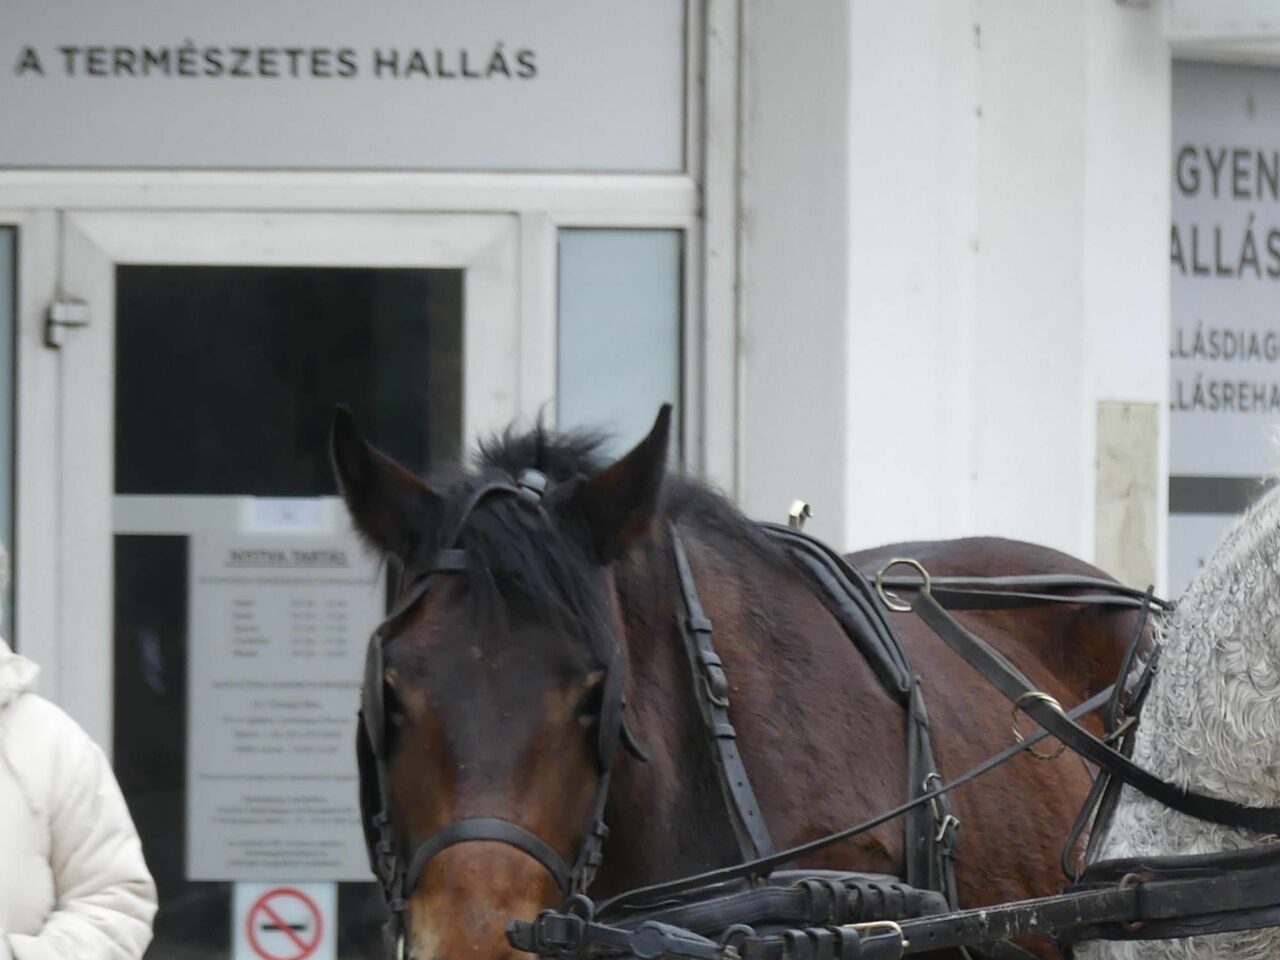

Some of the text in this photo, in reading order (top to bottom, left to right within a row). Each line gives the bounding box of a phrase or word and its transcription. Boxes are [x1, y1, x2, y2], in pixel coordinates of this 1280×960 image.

[15, 37, 537, 78] A TERMÉSZETES HALLÁS
